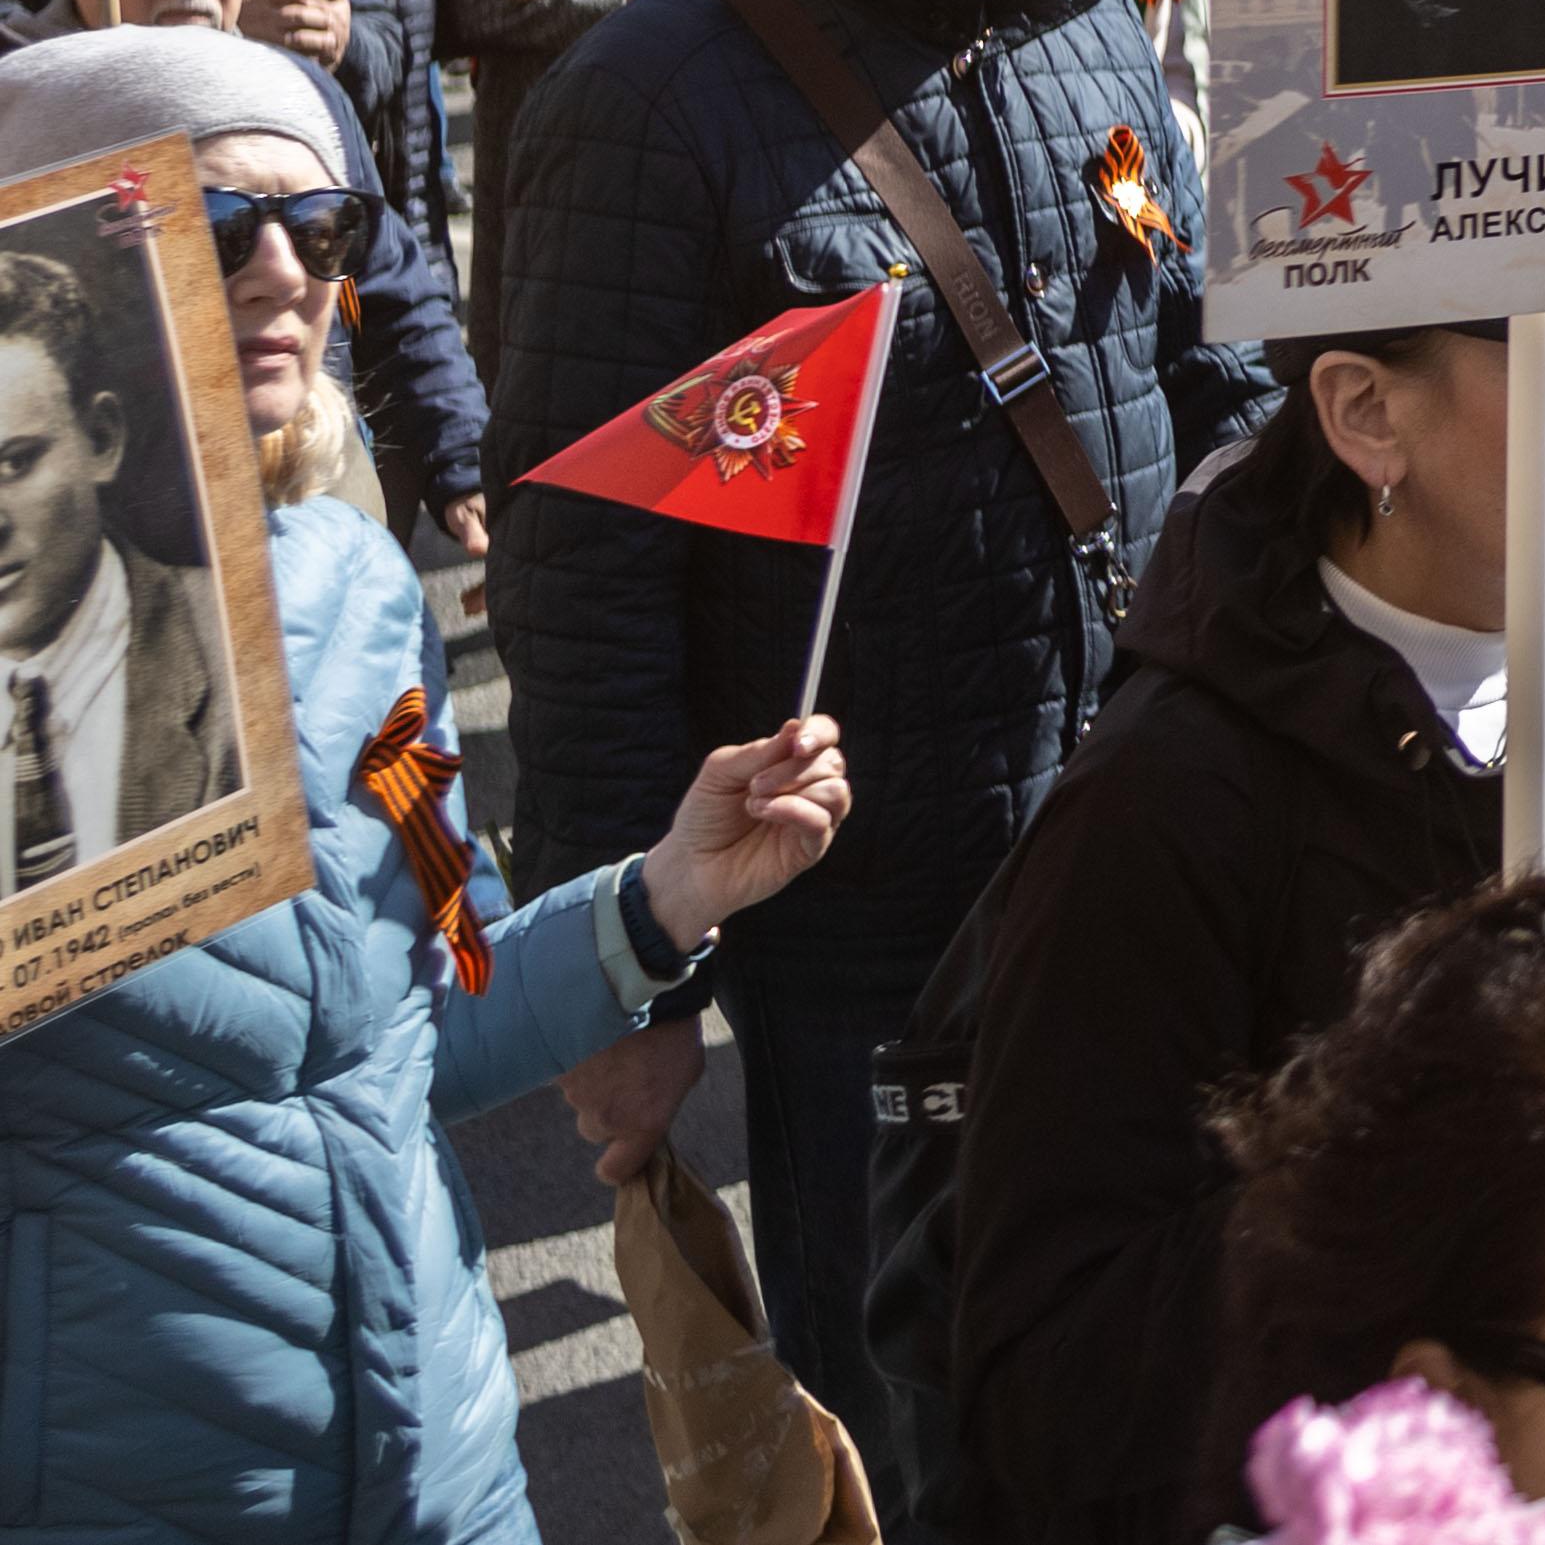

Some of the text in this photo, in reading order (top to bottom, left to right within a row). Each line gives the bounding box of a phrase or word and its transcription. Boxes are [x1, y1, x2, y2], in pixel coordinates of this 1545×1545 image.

[1283, 258, 1373, 290] ПОЛК
[13, 815, 261, 951] ИВАН СТЕПАНОВИЧ
[13, 923, 112, 989] 07.1942
